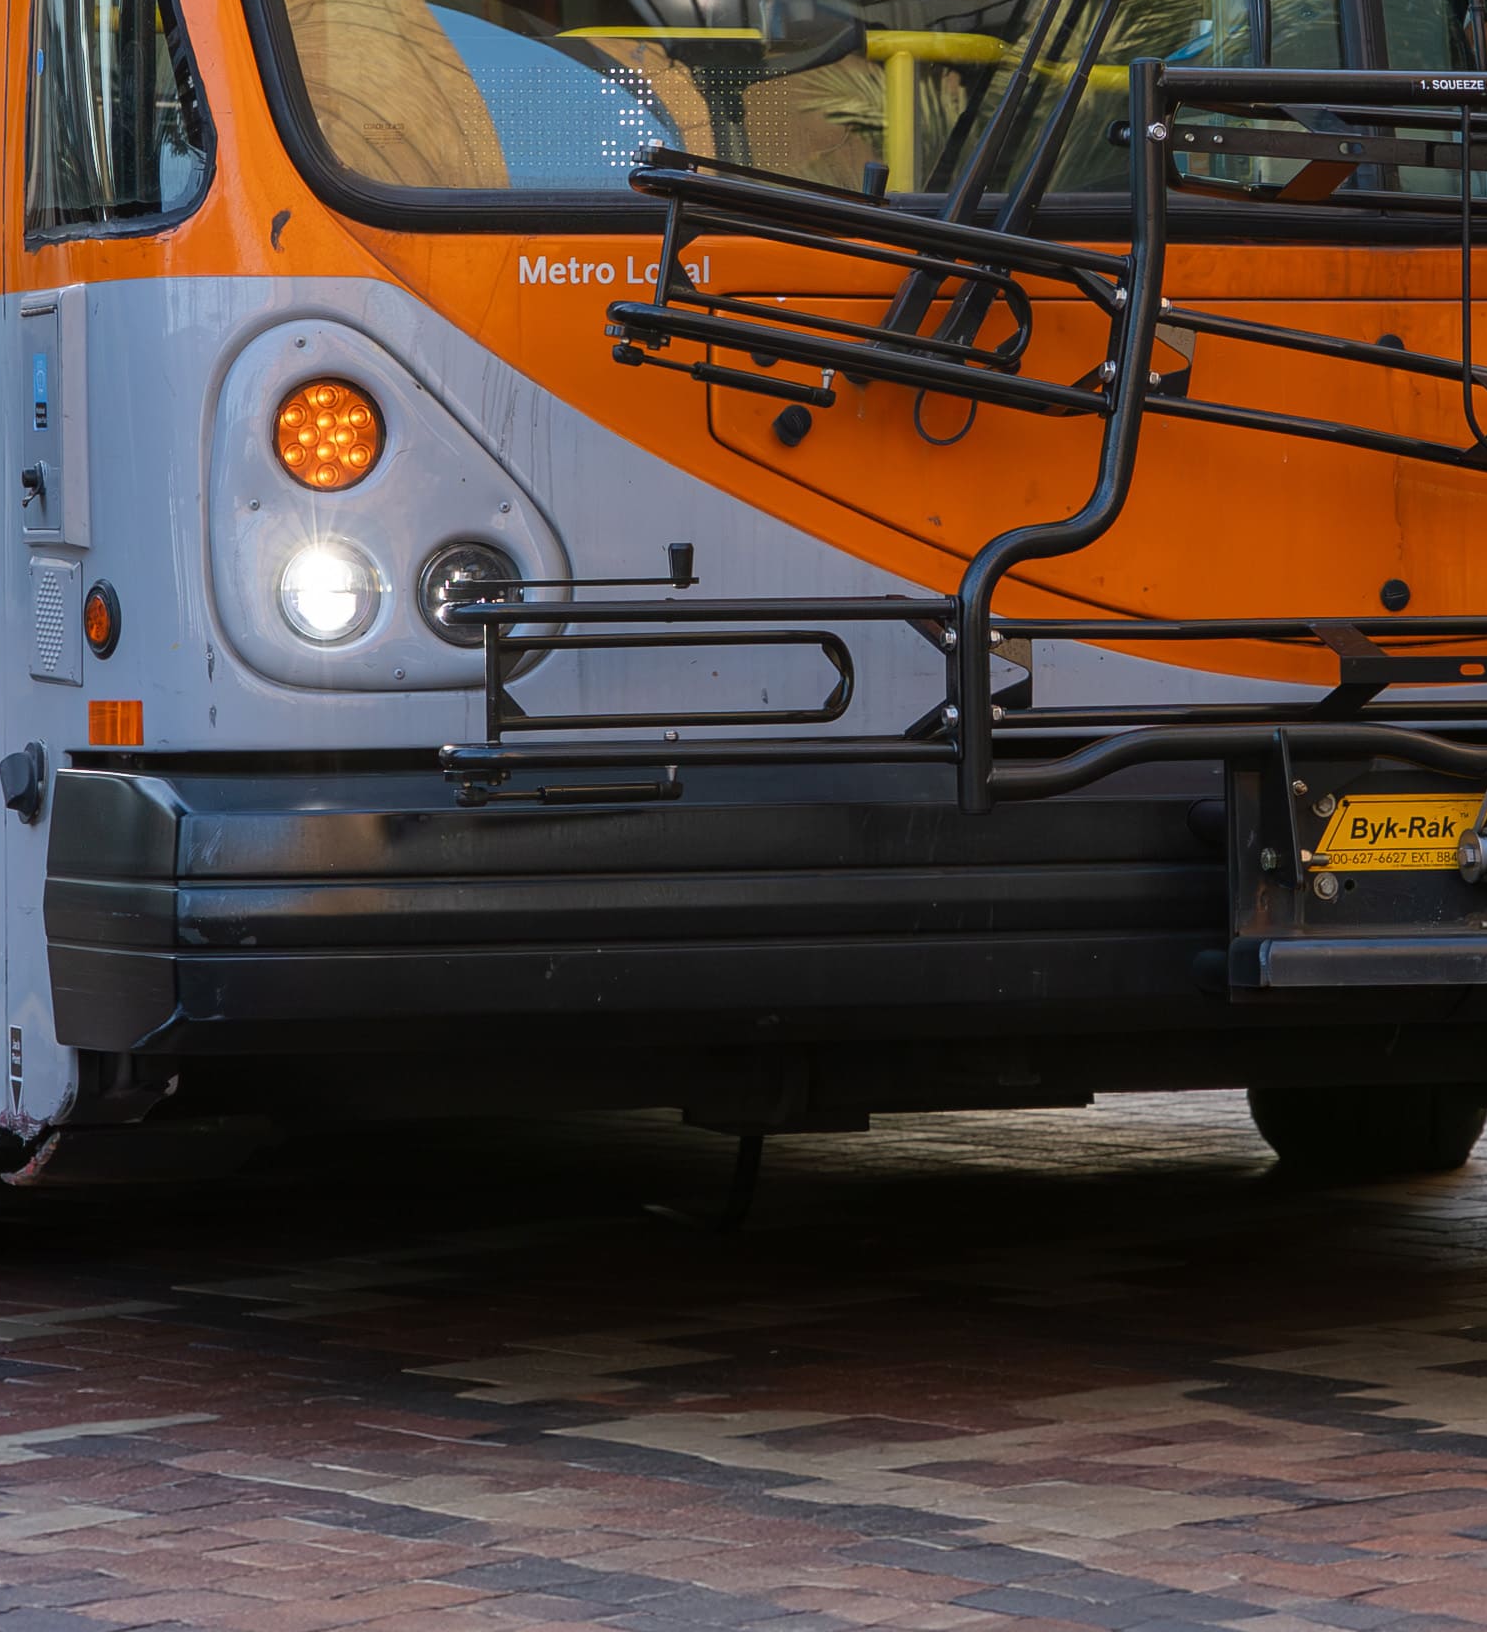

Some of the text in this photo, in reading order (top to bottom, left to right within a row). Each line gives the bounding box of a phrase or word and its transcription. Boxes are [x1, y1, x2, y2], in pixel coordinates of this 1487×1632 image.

[1420, 80, 1430, 90] 1.
[1432, 79, 1485, 90] SQUEEZE
[519, 255, 710, 284] Metro Loal
[1350, 816, 1456, 844] Byk-Rak
[1411, 852, 1434, 863] EXT.
